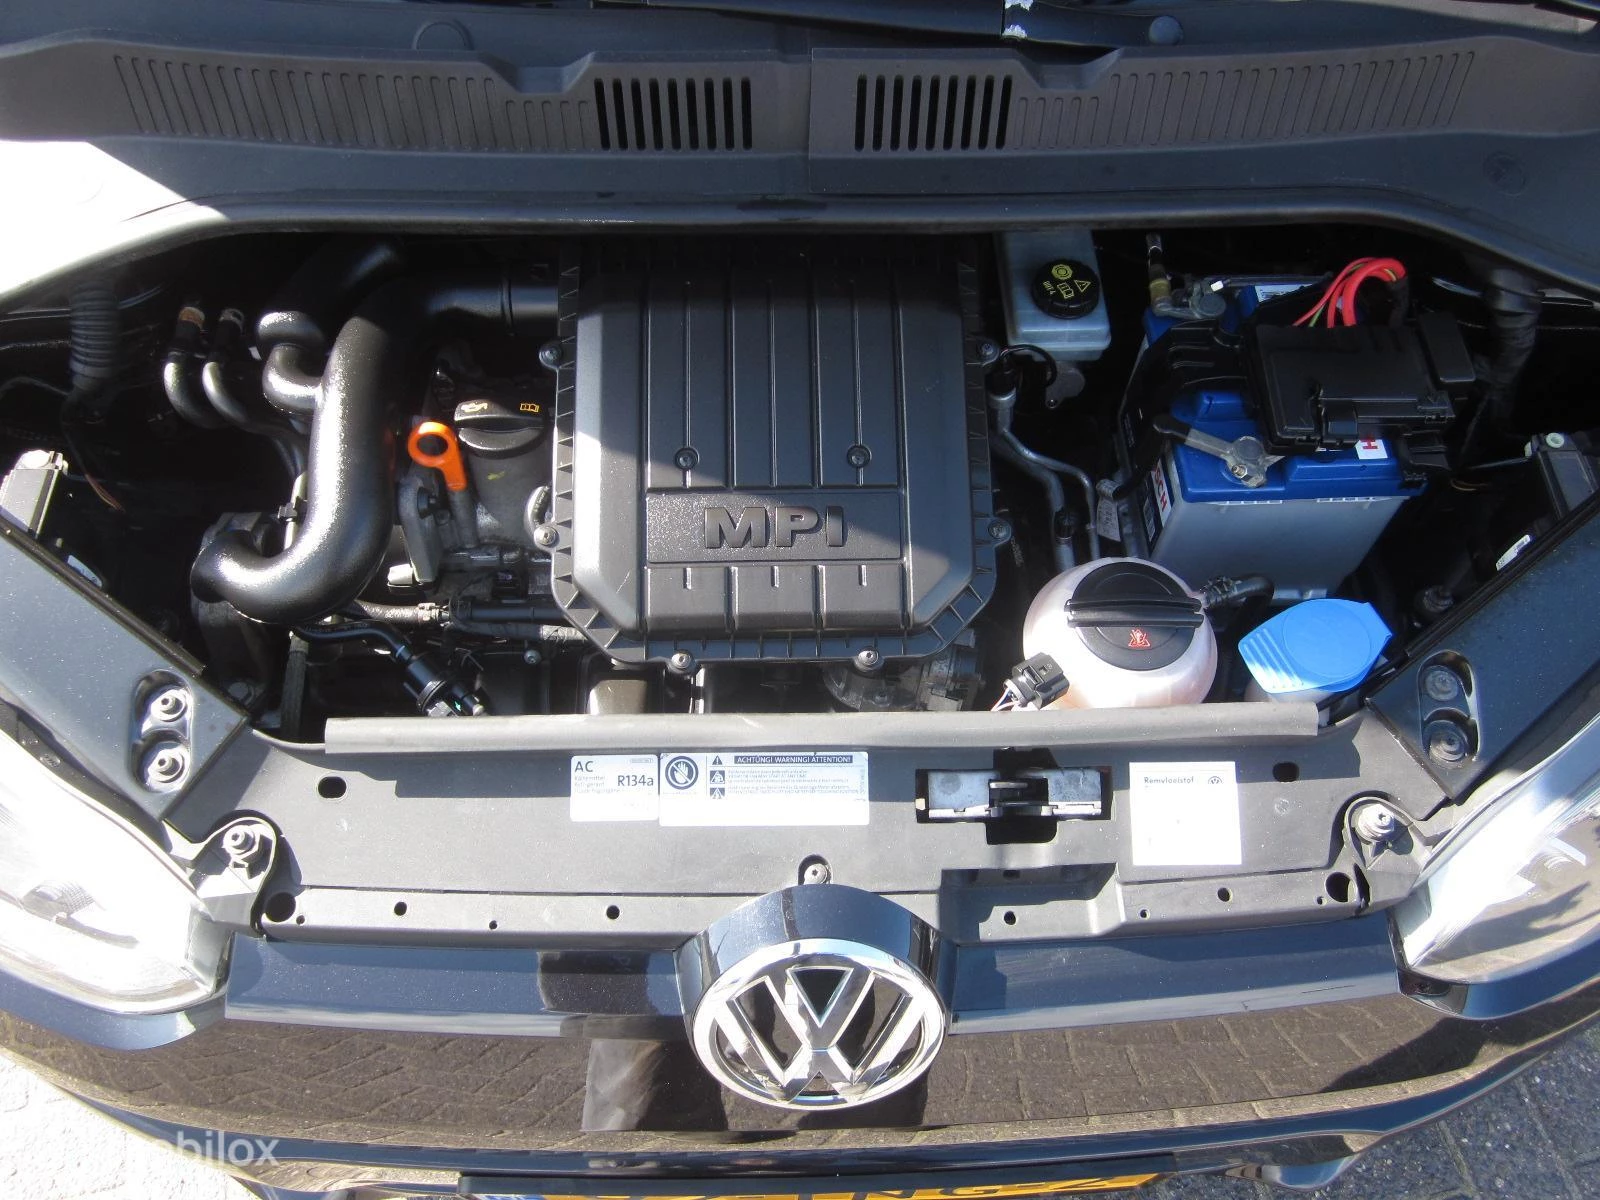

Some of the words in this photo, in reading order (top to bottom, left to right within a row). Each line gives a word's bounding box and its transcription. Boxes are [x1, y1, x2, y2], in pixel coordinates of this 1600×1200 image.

[704, 506, 846, 549] MPI
[775, 755, 810, 763] WARNING!
[811, 755, 851, 763] ATTENTION!
[574, 760, 594, 773] AC
[617, 774, 654, 787] R134a
[1143, 776, 1194, 784] Remvloeistof
